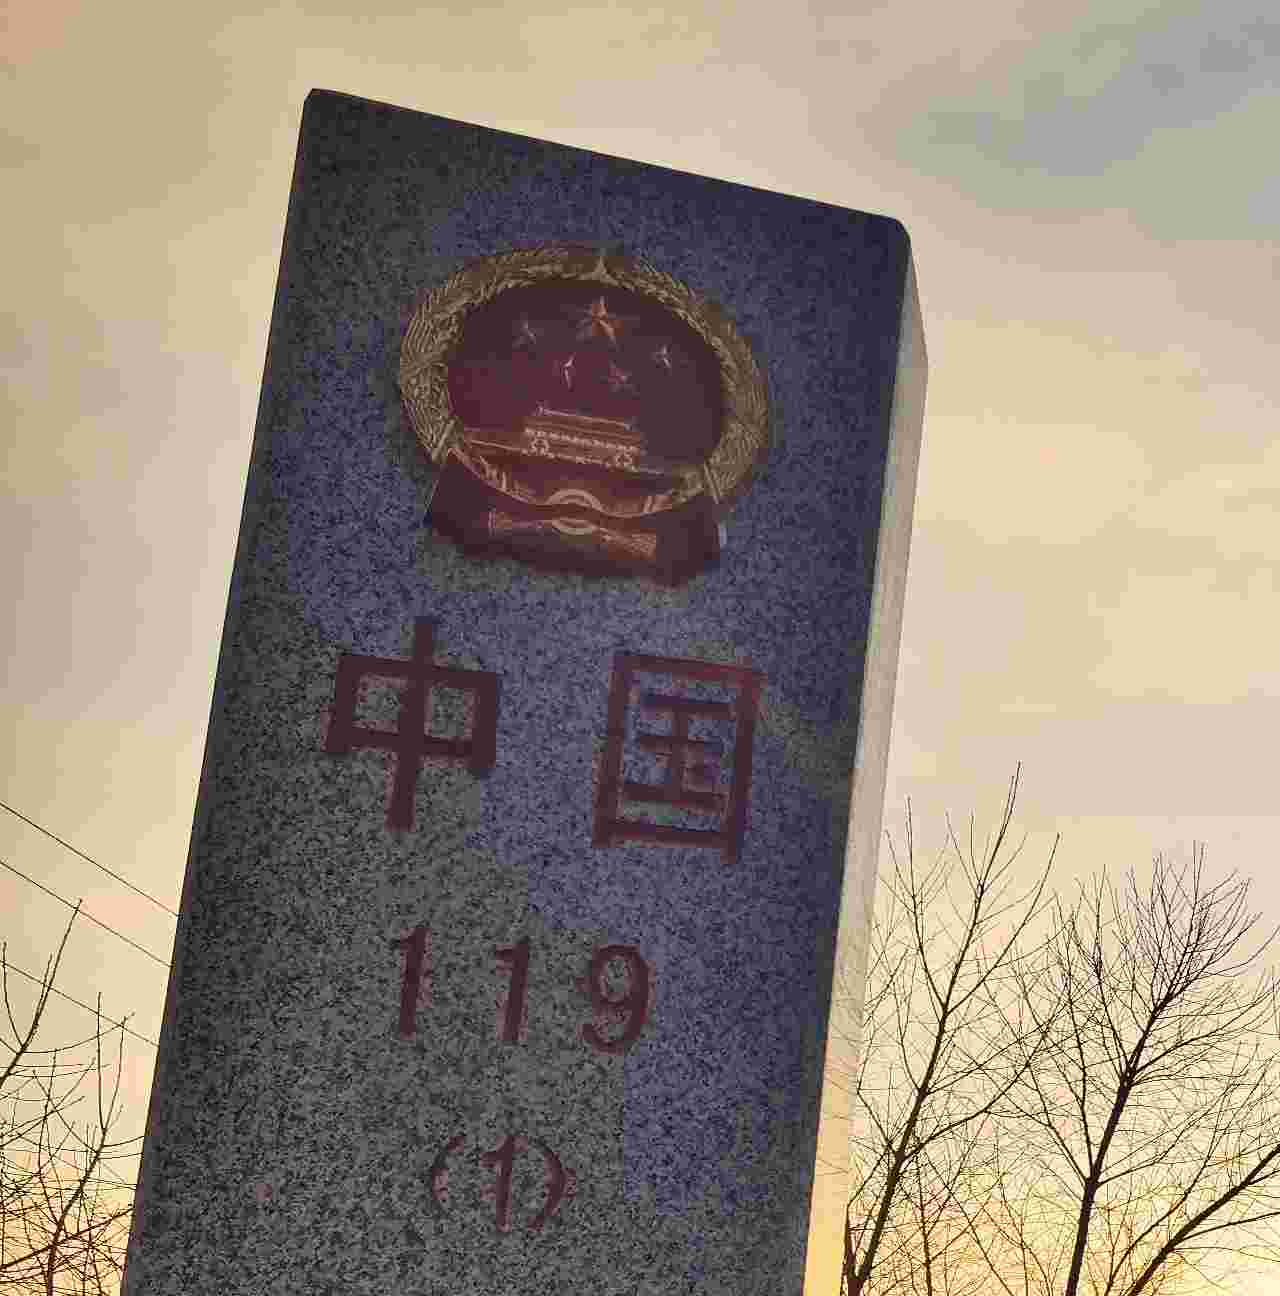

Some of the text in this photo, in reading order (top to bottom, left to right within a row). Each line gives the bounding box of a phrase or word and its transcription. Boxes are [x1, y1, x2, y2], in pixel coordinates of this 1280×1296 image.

[320, 615, 768, 865] 中国
[396, 926, 657, 1056] 119
[428, 1134, 568, 1234] (1)
